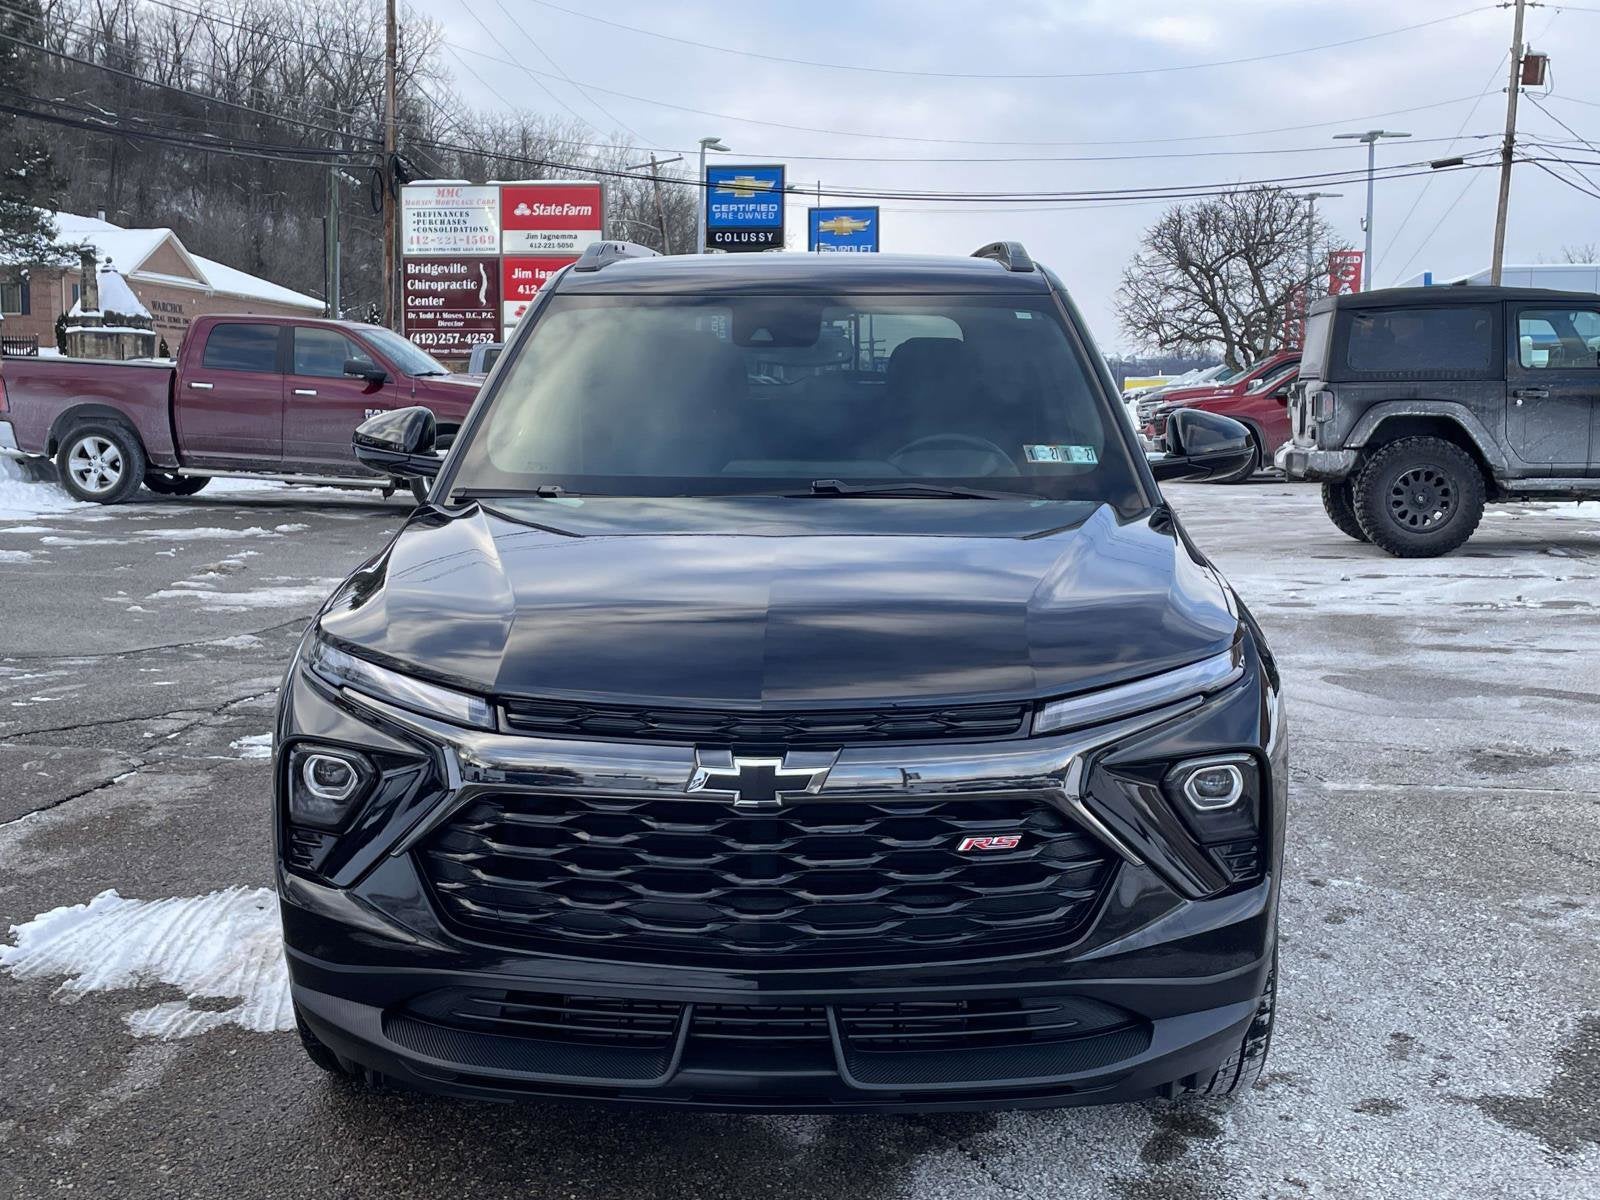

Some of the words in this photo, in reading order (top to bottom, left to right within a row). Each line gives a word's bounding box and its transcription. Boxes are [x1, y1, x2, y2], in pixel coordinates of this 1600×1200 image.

[436, 188, 463, 198] MMC
[712, 204, 778, 212] CERTIFIED
[416, 226, 489, 234] CONSOLIDATIONS
[409, 235, 495, 246] 412-221-1569
[715, 232, 774, 242] COLUSSY
[407, 263, 468, 276] Bridgeville
[511, 268, 532, 279] Jim
[407, 279, 478, 291] Chiropractic
[407, 296, 445, 306] Center
[151, 300, 184, 314] WARCHOL
[957, 834, 1022, 851] RS
